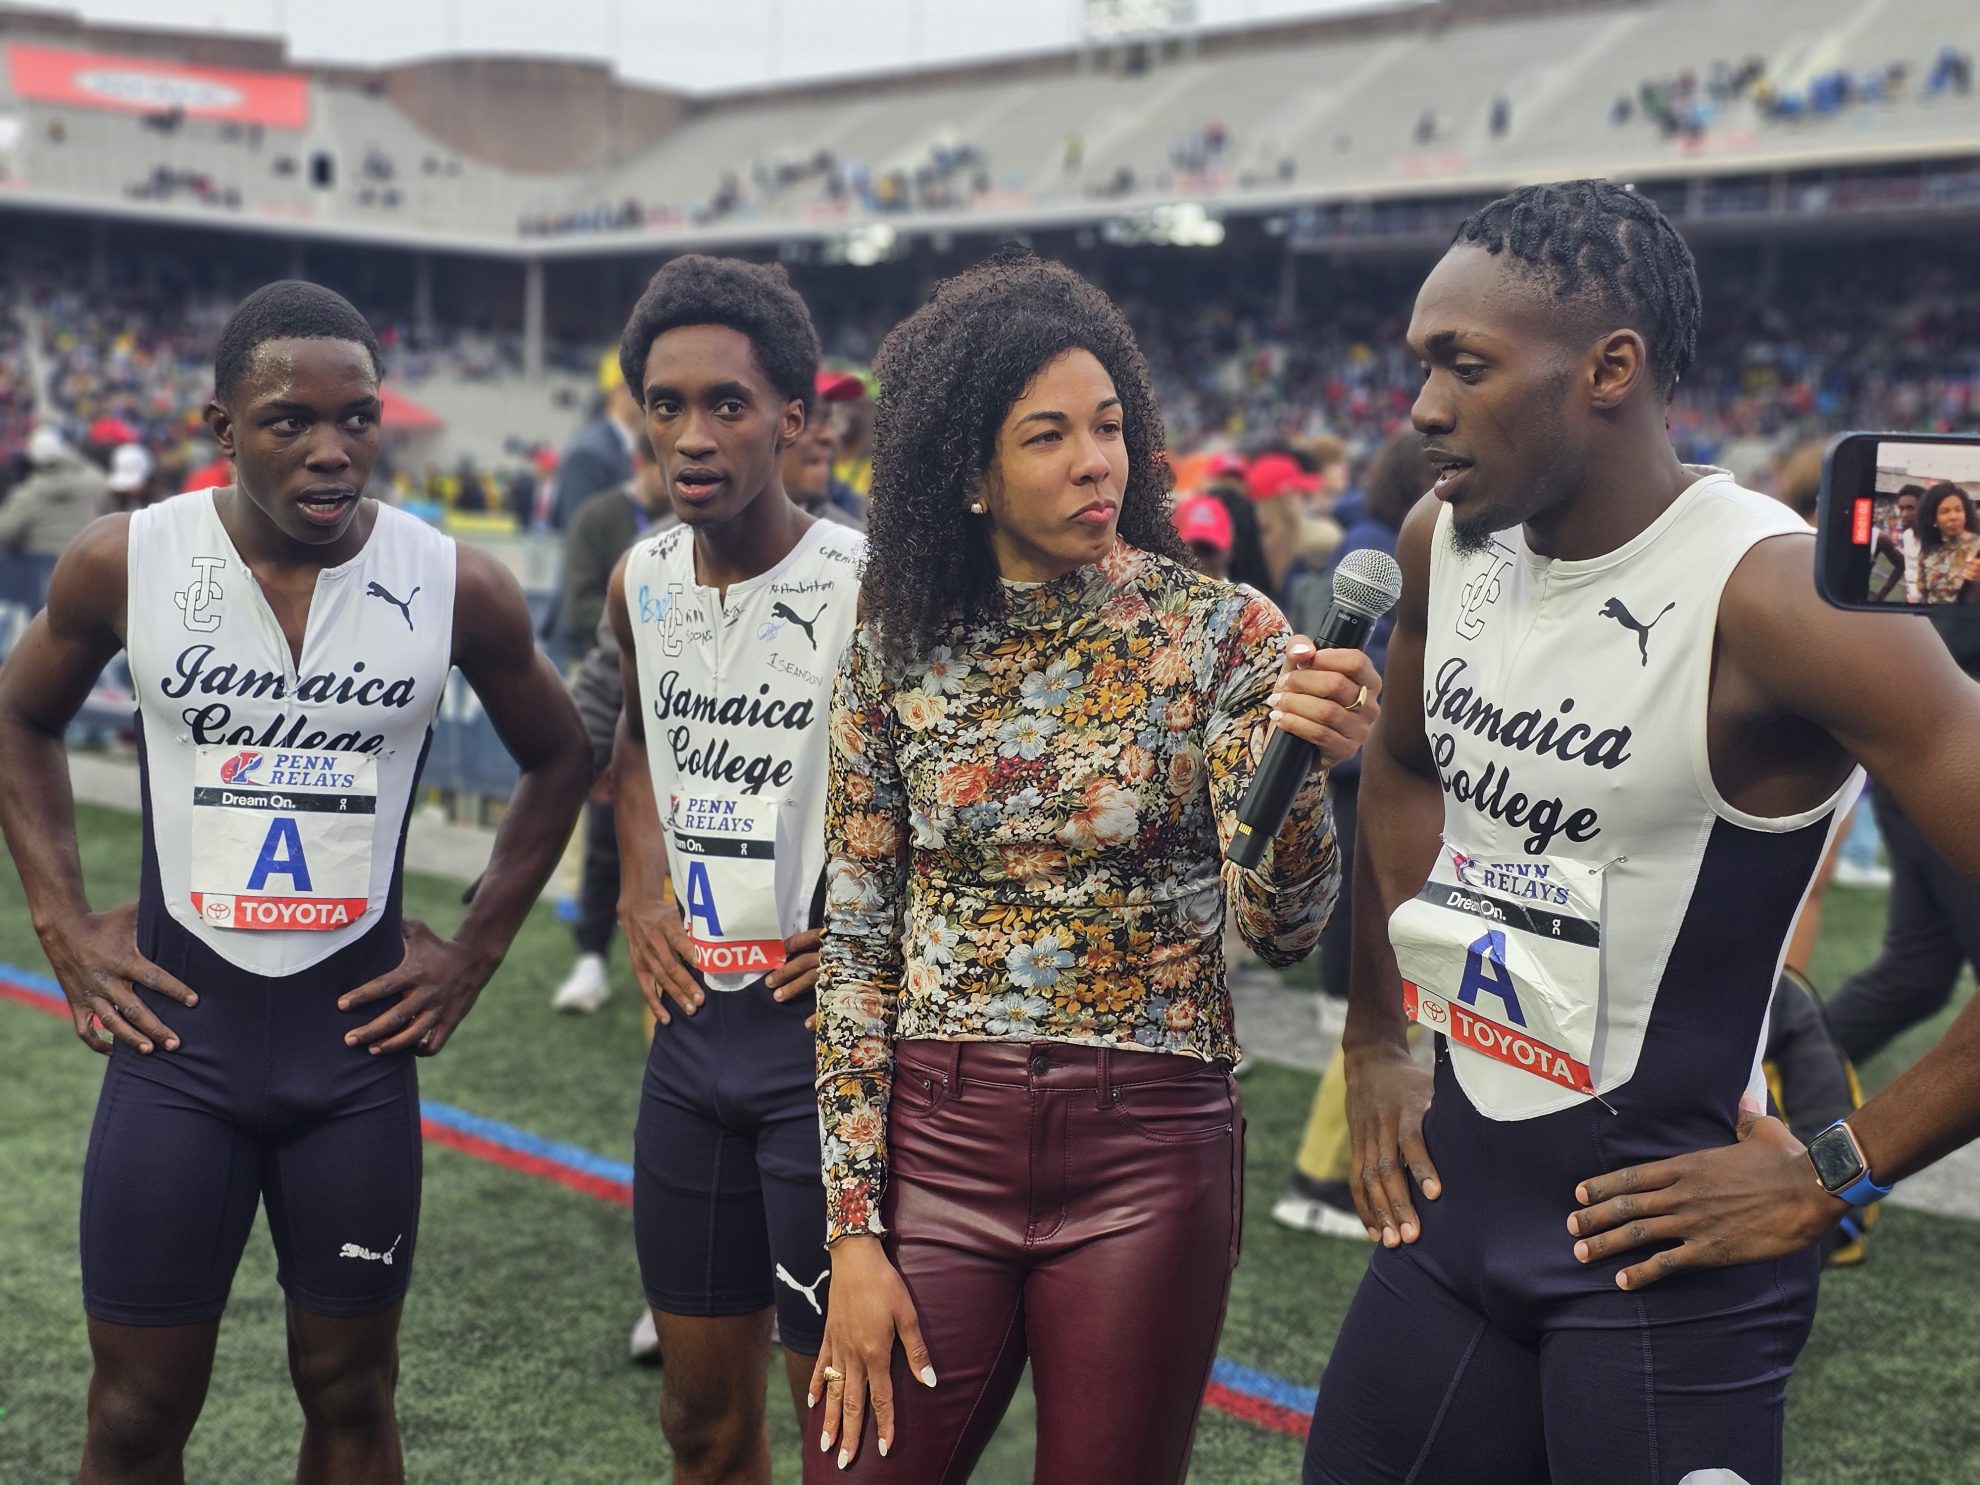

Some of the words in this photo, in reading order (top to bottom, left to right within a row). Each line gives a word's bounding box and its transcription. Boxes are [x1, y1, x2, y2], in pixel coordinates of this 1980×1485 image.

[161, 644, 415, 708] Jamaica
[654, 670, 815, 730] Jamaica
[1426, 657, 1632, 769] Jamaica
[269, 771, 354, 788] RELAYS
[274, 754, 337, 770] PENN
[667, 725, 793, 795] College
[222, 792, 267, 808] Dream
[270, 795, 296, 809] On.
[685, 814, 754, 832] RELAYS
[687, 798, 738, 814] PENN
[1431, 733, 1601, 855] College
[246, 817, 313, 892] A
[241, 902, 350, 925] TOYOTA
[687, 860, 724, 936] A
[1482, 869, 1569, 905] RELAYS
[695, 943, 768, 967] OYOTA
[1457, 929, 1527, 1028] A
[1456, 1011, 1575, 1084] TOYOTA
